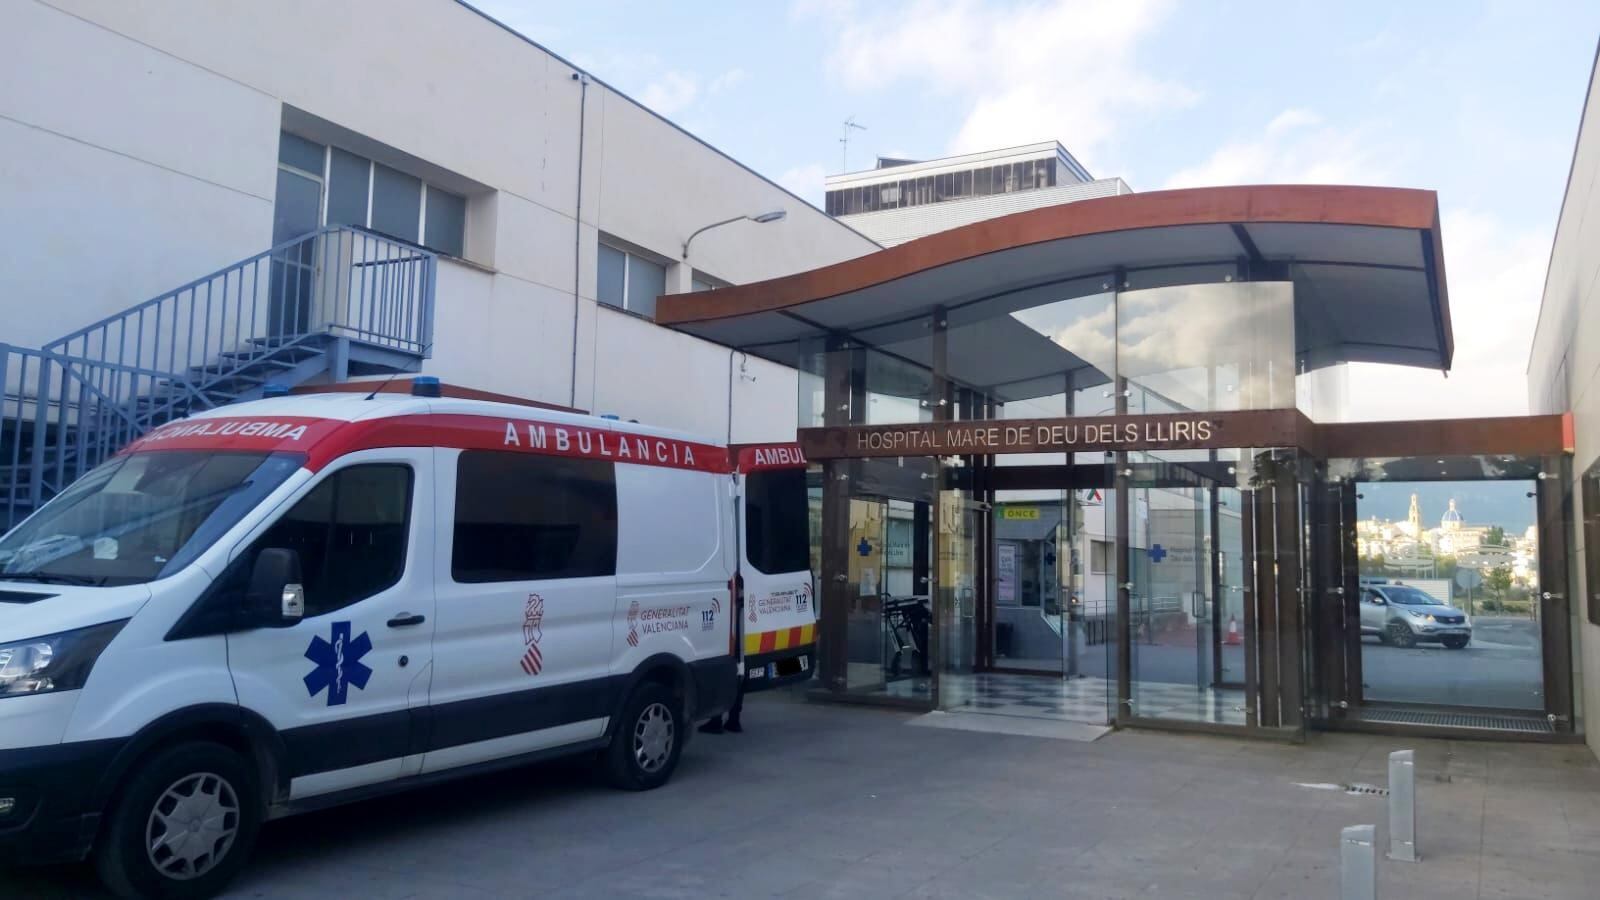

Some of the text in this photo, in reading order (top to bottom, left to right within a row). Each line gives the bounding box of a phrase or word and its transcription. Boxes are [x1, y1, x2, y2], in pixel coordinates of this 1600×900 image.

[857, 420, 1212, 450] HOSPITAL MARE DE DEU DELS LLIRIS
[503, 421, 696, 466] AMBULANCIA
[755, 446, 807, 465] AMBUL
[1007, 510, 1035, 518] ONCE
[796, 593, 807, 604] 112
[641, 606, 691, 621] GENERALITAT
[701, 609, 714, 621] 112
[642, 619, 689, 634] VALENCIANA
